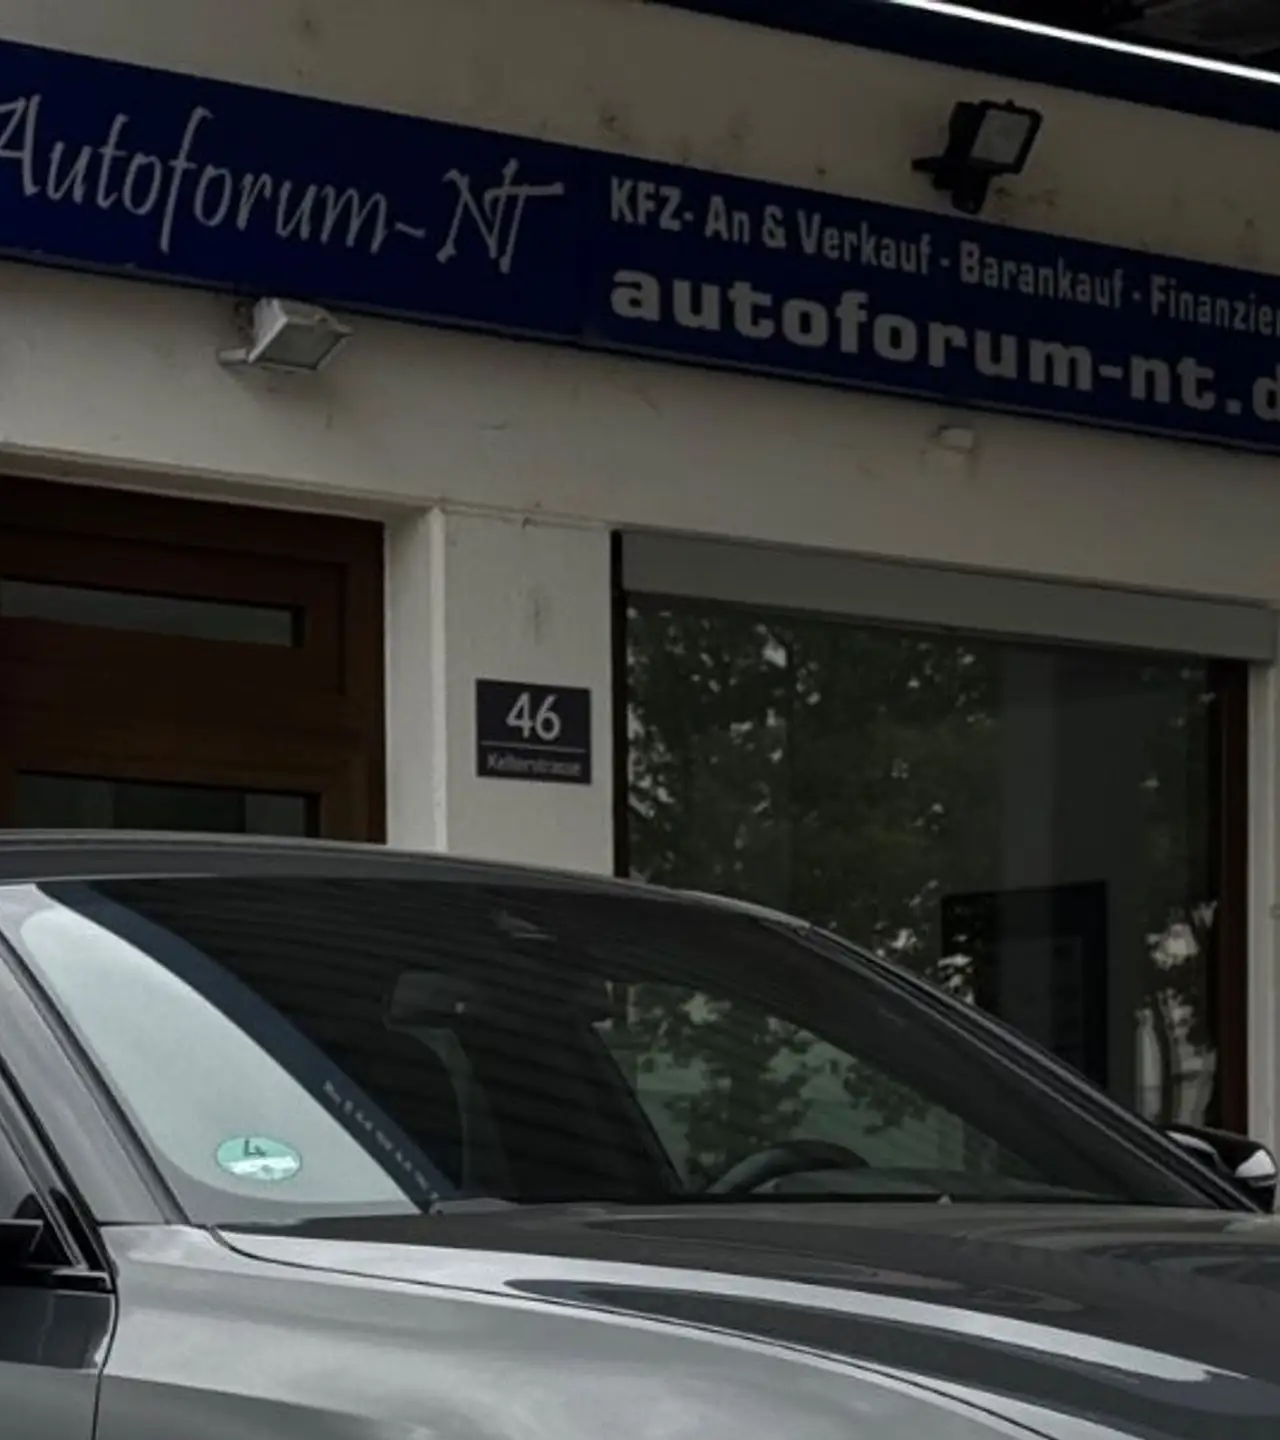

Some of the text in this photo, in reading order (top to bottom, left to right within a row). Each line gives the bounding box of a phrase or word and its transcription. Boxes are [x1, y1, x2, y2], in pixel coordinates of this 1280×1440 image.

[704, 193, 752, 246] An
[761, 206, 788, 250] &
[797, 209, 933, 275] Verkauf
[959, 239, 1125, 308] Barankauf
[505, 691, 562, 742] 46
